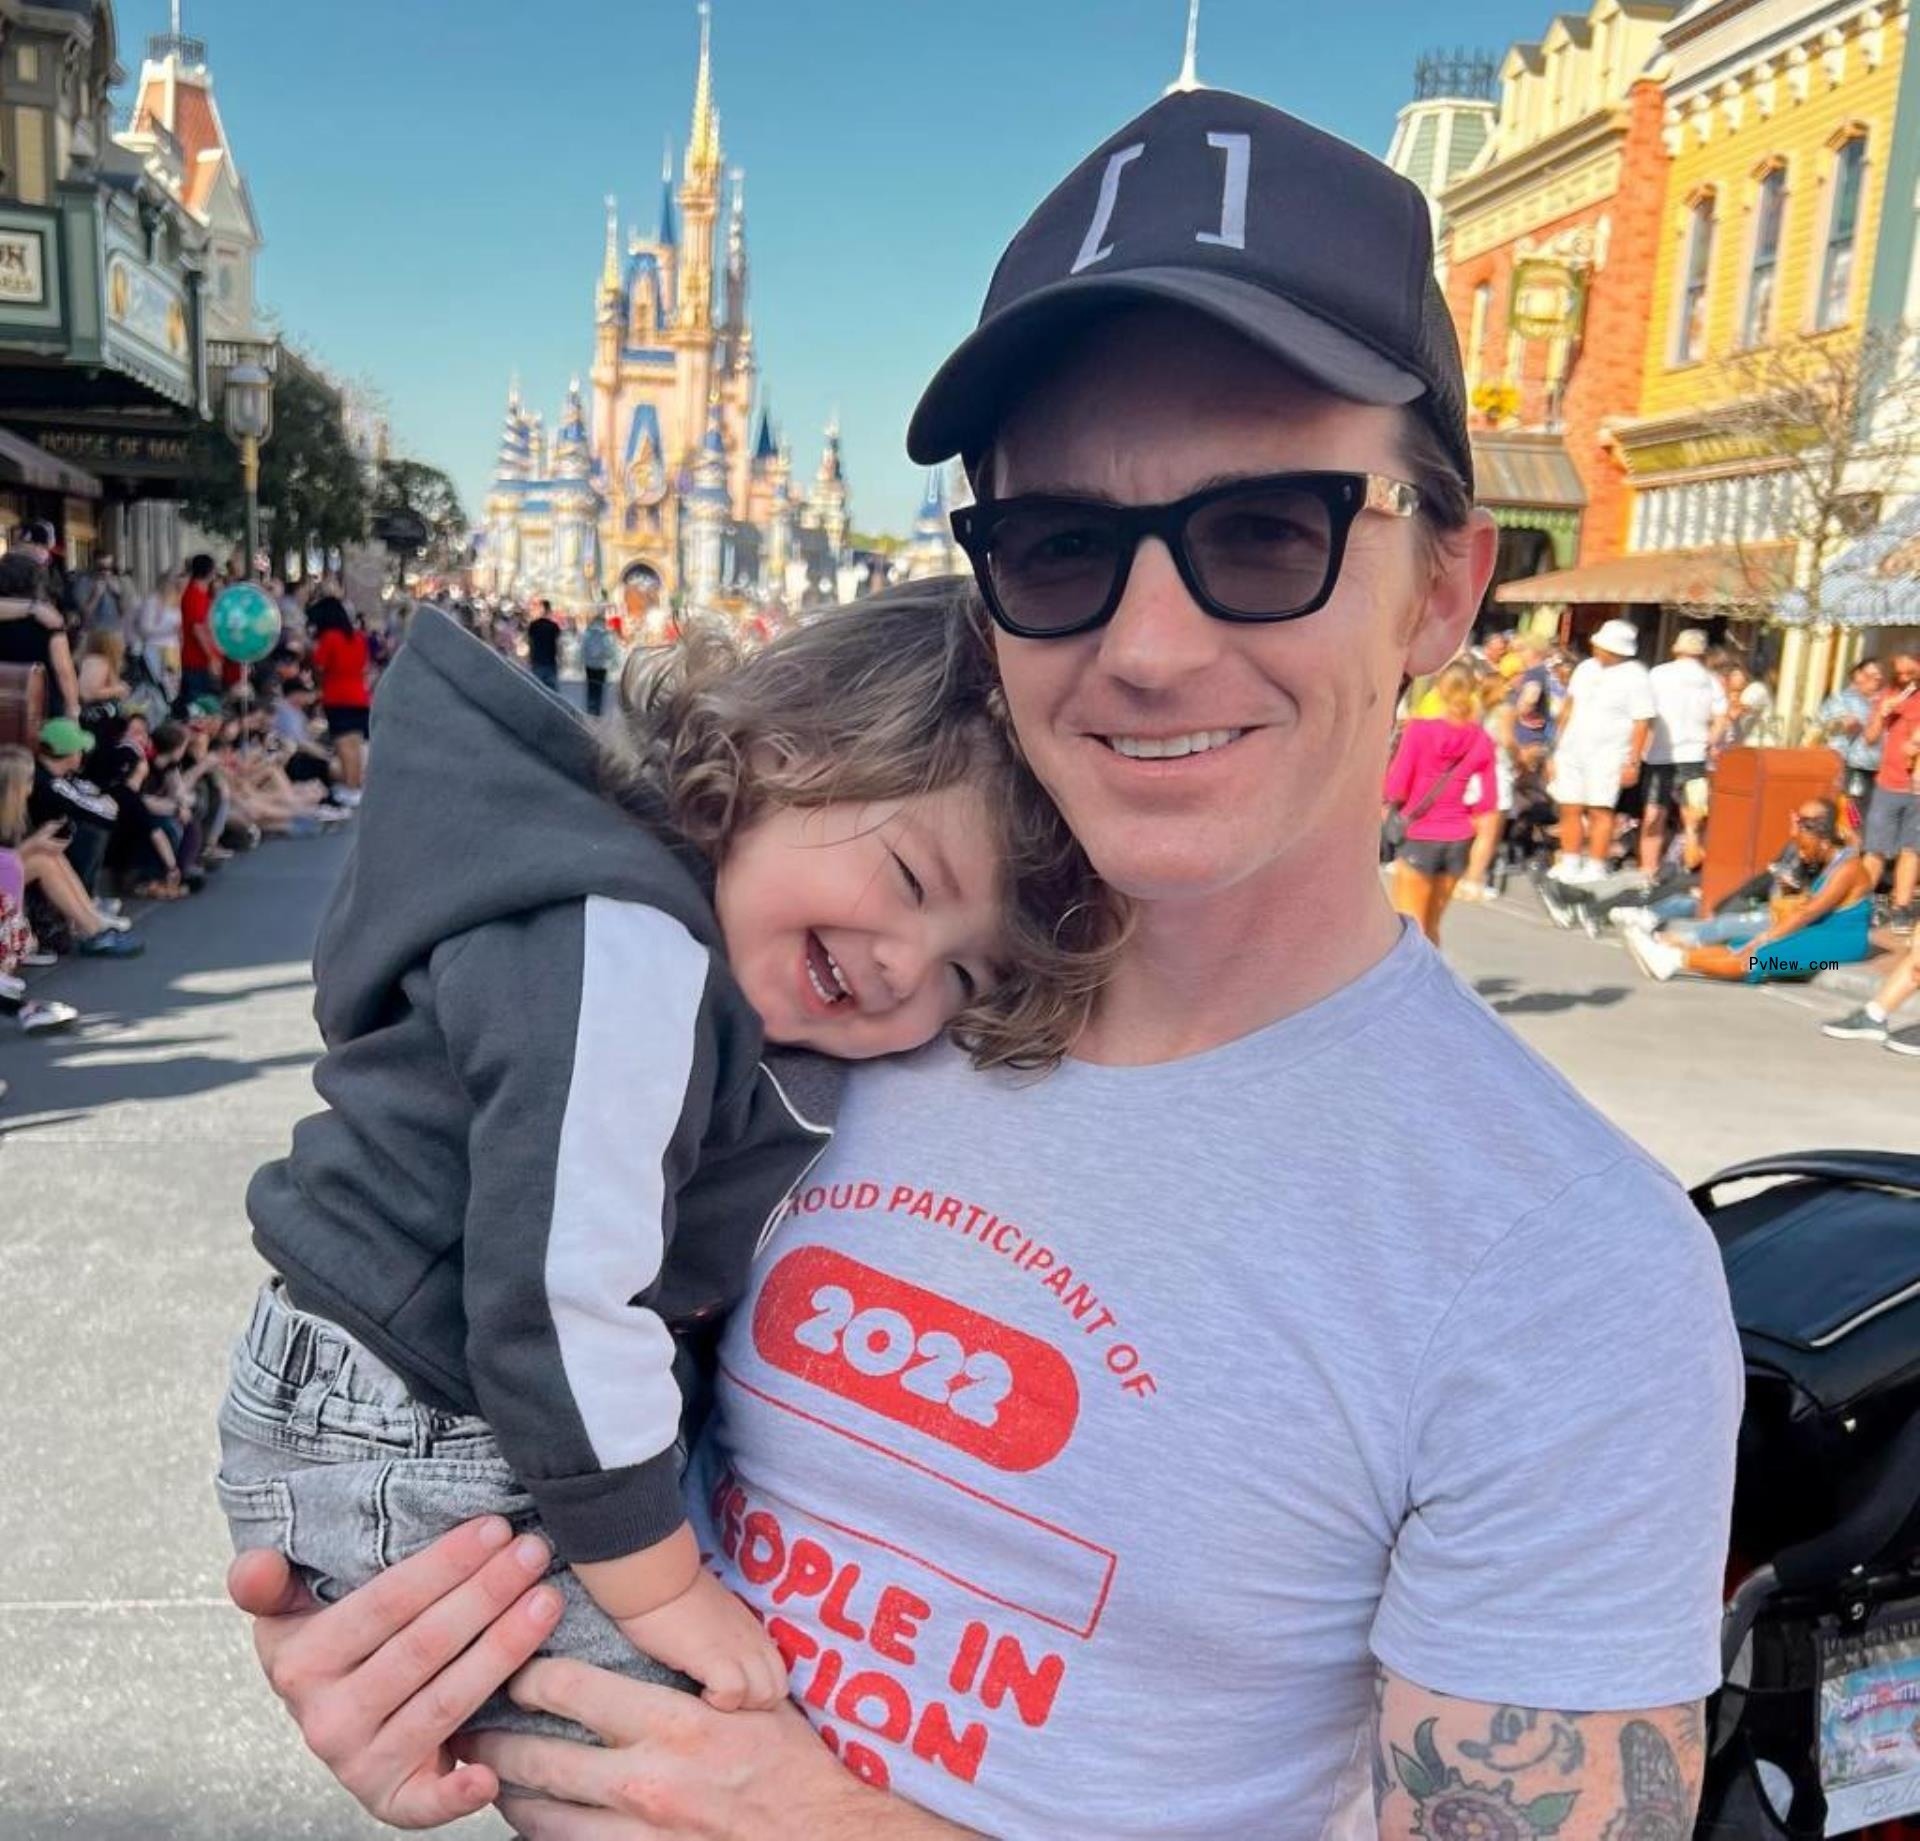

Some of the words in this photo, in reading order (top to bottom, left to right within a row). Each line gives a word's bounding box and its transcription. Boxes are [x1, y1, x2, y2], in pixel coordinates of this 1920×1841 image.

[118, 436, 144, 457] OF
[787, 1182, 881, 1216] OUD
[887, 1184, 1116, 1336] PARTICIPANT
[1104, 1341, 1158, 1401] OF
[793, 1284, 1013, 1429] 2022
[948, 1620, 1066, 1728] IN
